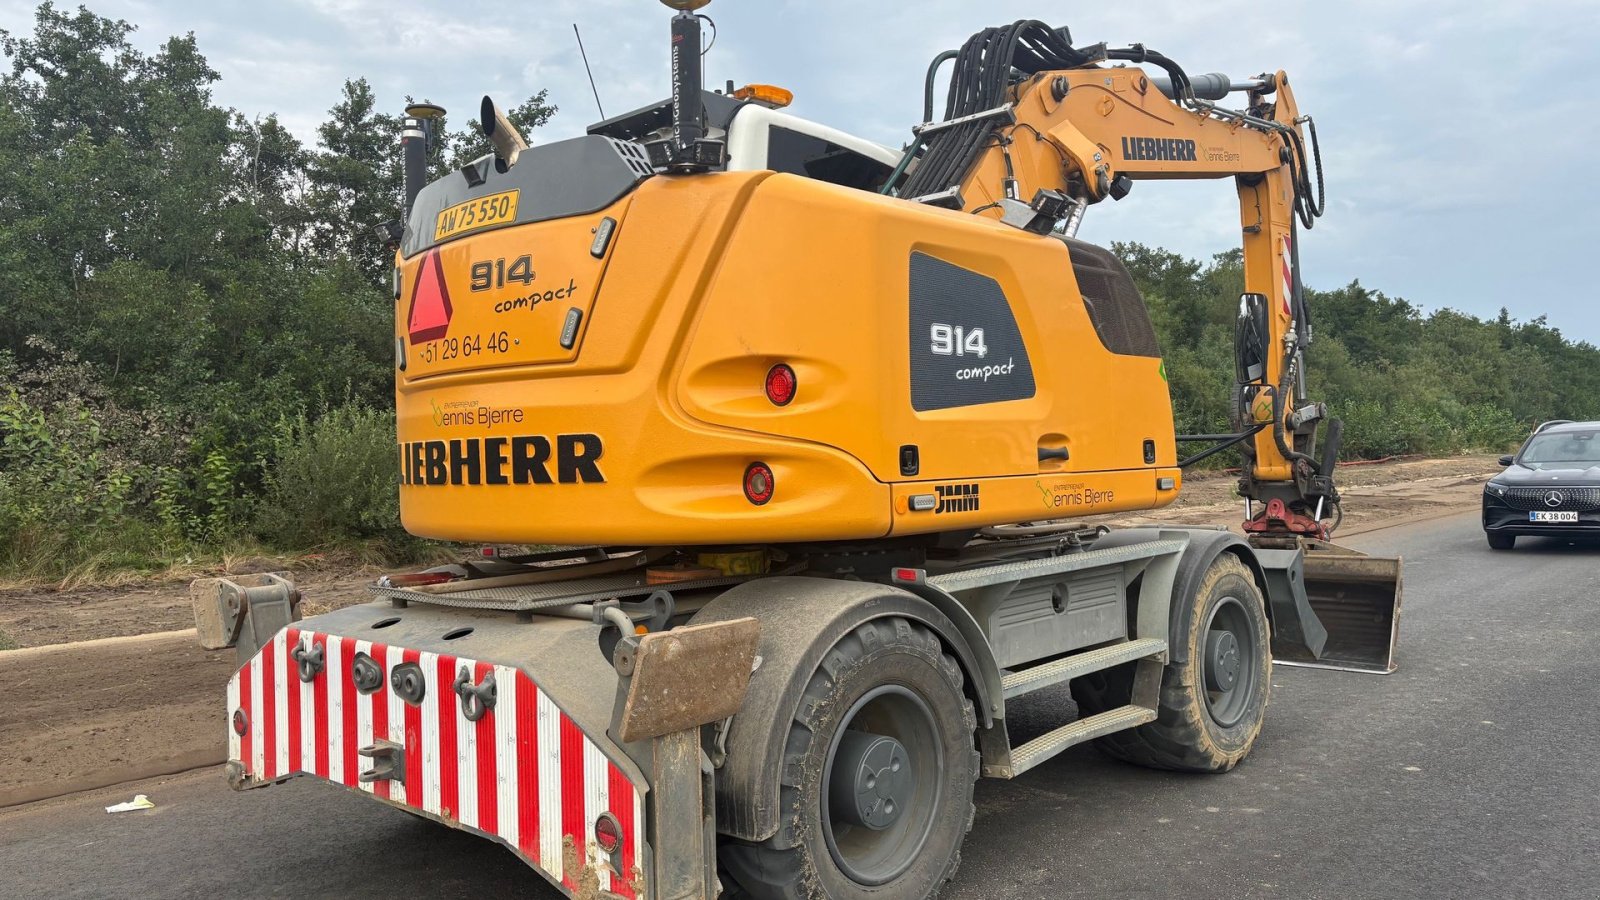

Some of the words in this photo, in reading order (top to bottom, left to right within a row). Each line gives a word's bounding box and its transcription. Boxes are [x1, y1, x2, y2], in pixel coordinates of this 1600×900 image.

[672, 45, 681, 118] Geosystems
[1121, 136, 1197, 162] LIEBHERR
[439, 209, 458, 235] AW
[459, 202, 476, 228] 75
[478, 195, 509, 222] 550
[470, 253, 536, 293] 914
[494, 278, 578, 314] compact
[426, 341, 437, 363] 51
[443, 338, 458, 360] 29
[463, 334, 481, 357] 64
[487, 331, 509, 354] 46
[930, 322, 987, 358] 914
[955, 356, 1015, 382] compact
[477, 406, 524, 429] Bjerre
[398, 433, 607, 486] LIEBHERR
[934, 483, 979, 514] JMM
[1084, 488, 1114, 508] Bjerre
[1536, 512, 1547, 520] EK
[1548, 512, 1559, 520] 38
[1560, 512, 1577, 520] 004
